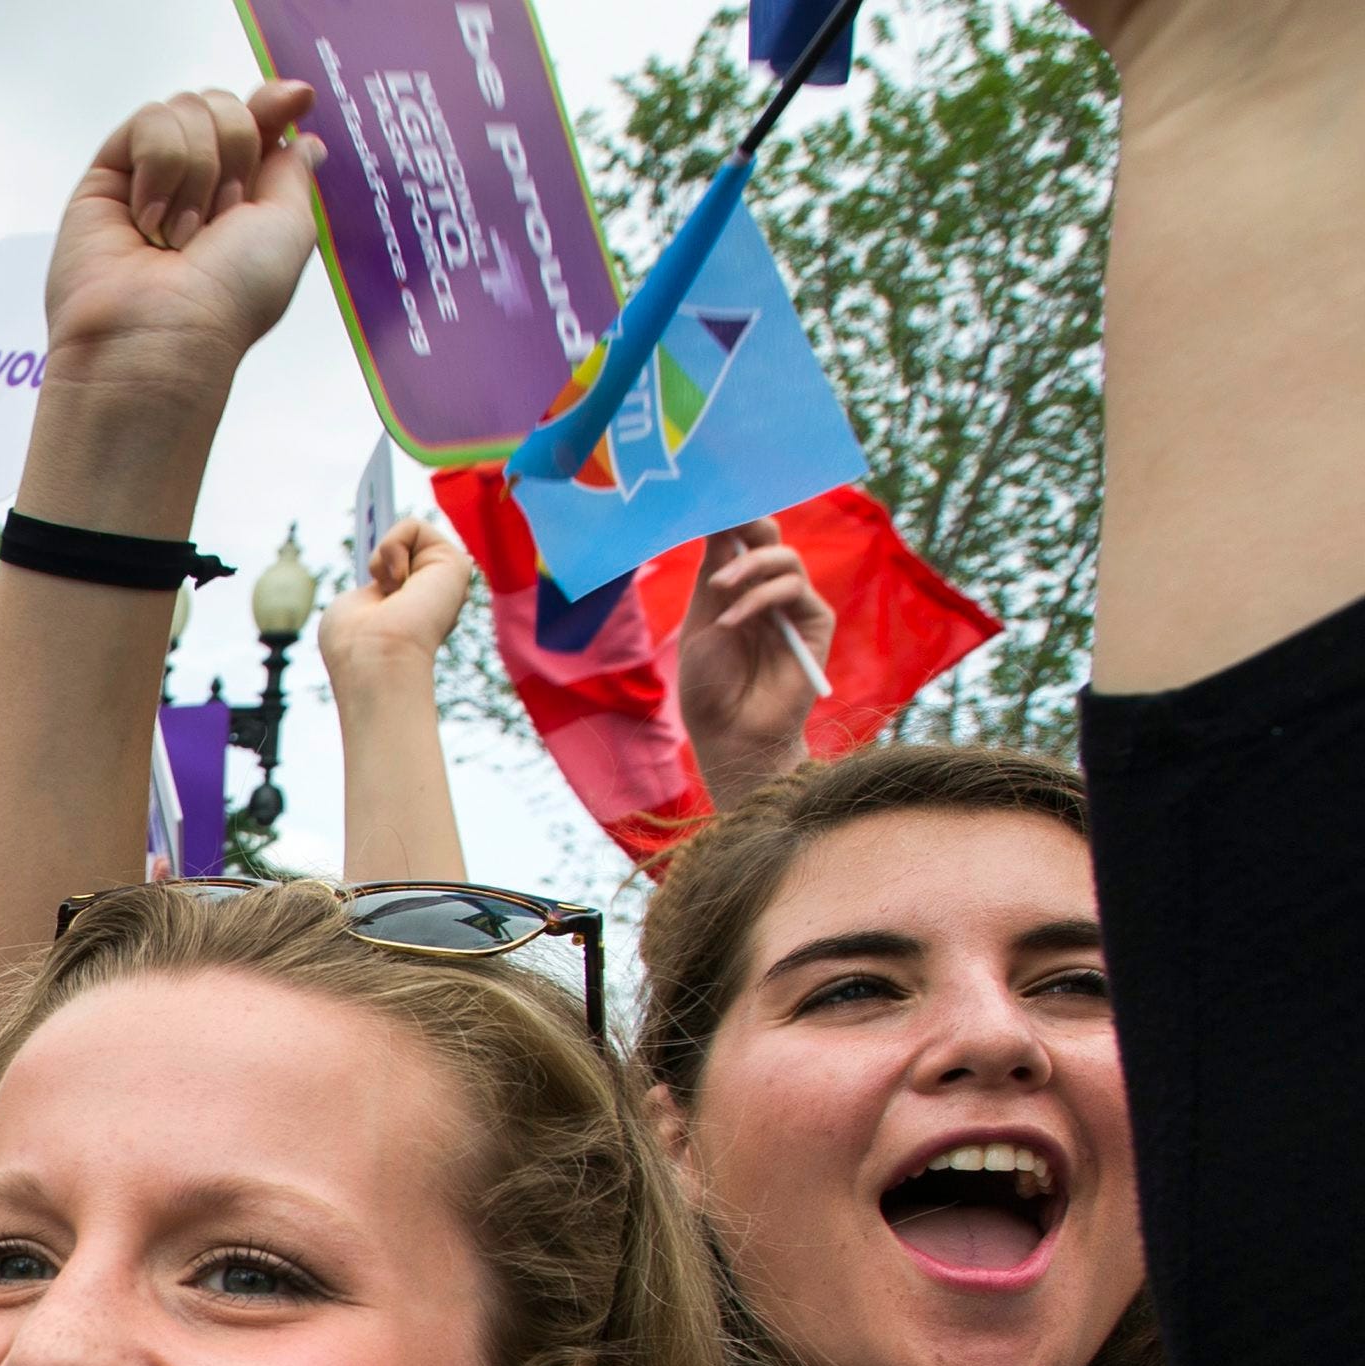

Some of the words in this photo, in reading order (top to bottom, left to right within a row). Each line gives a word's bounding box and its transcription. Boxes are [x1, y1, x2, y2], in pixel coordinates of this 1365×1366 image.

[455, 1, 505, 110] be
[364, 70, 416, 178] TASK
[403, 180, 459, 322] FORCE
[383, 70, 468, 271] LGBTQ
